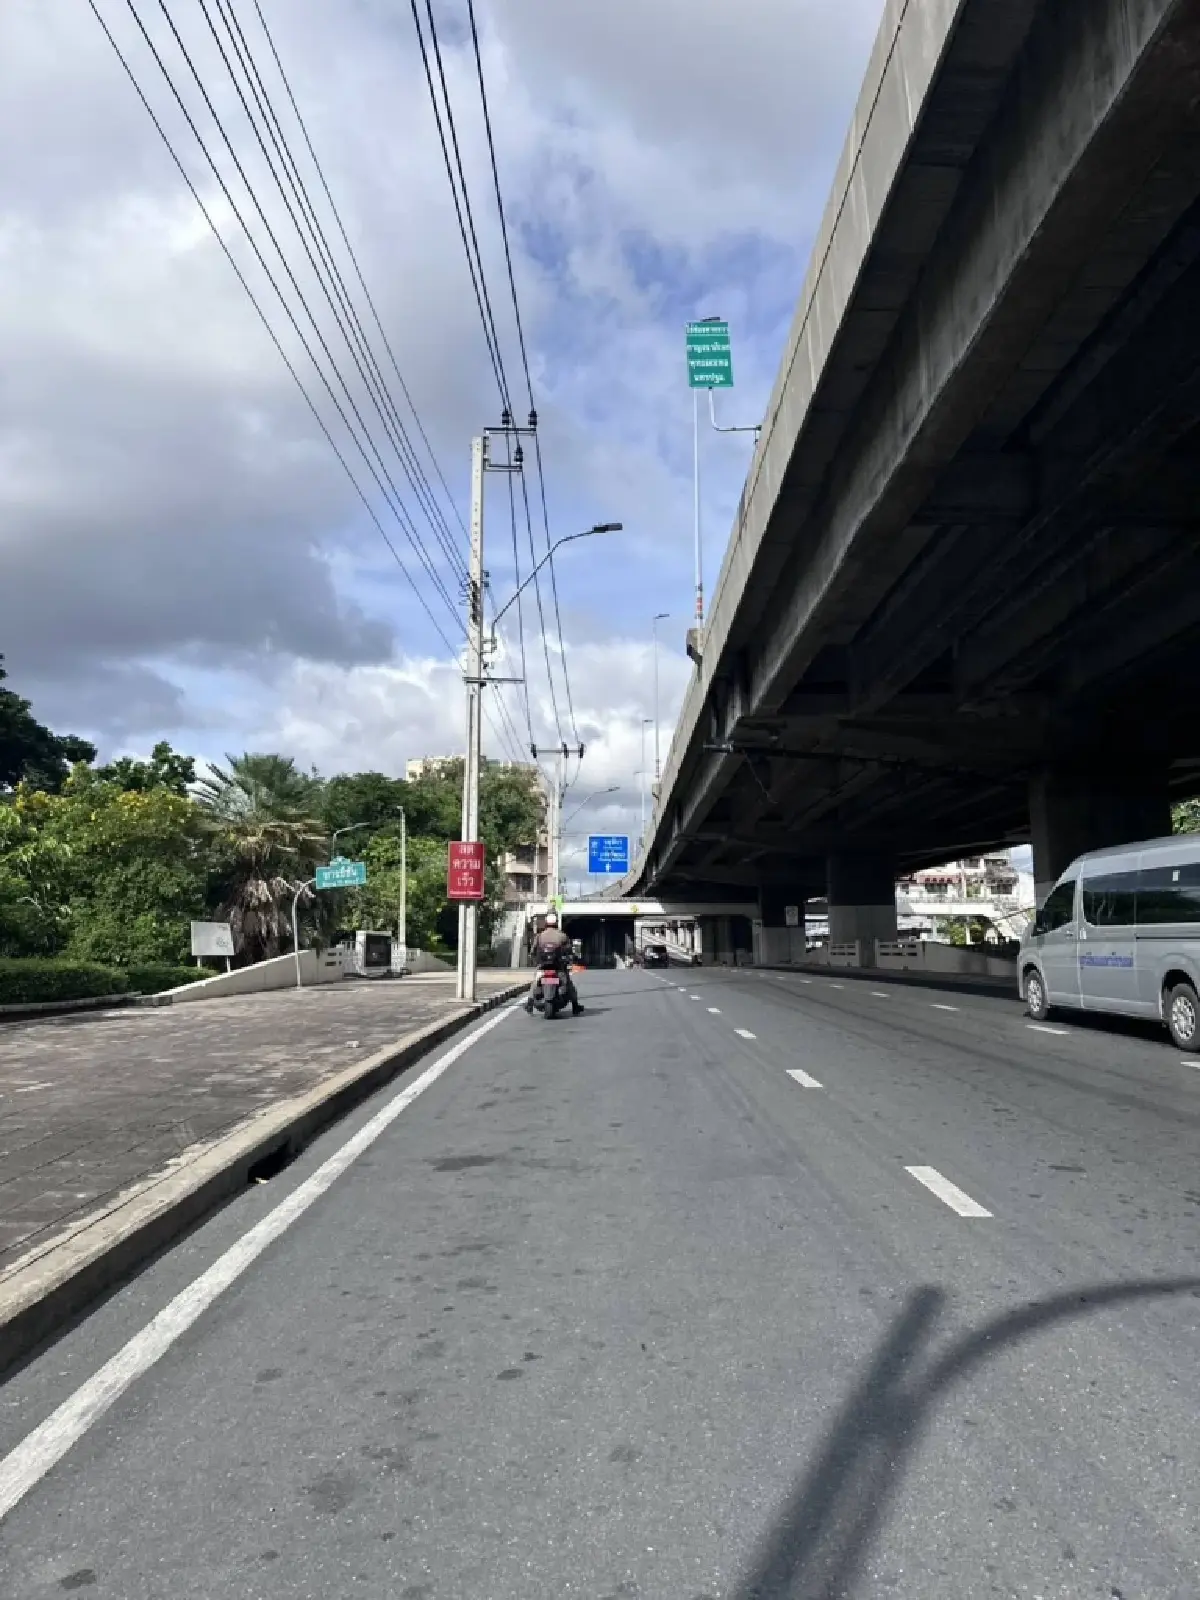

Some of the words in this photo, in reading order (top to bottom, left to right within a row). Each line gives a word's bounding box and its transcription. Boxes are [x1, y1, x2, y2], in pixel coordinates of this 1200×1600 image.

[459, 844, 474, 855] ลด
[452, 858, 481, 870] ความ
[457, 871, 474, 887] เร็ว
